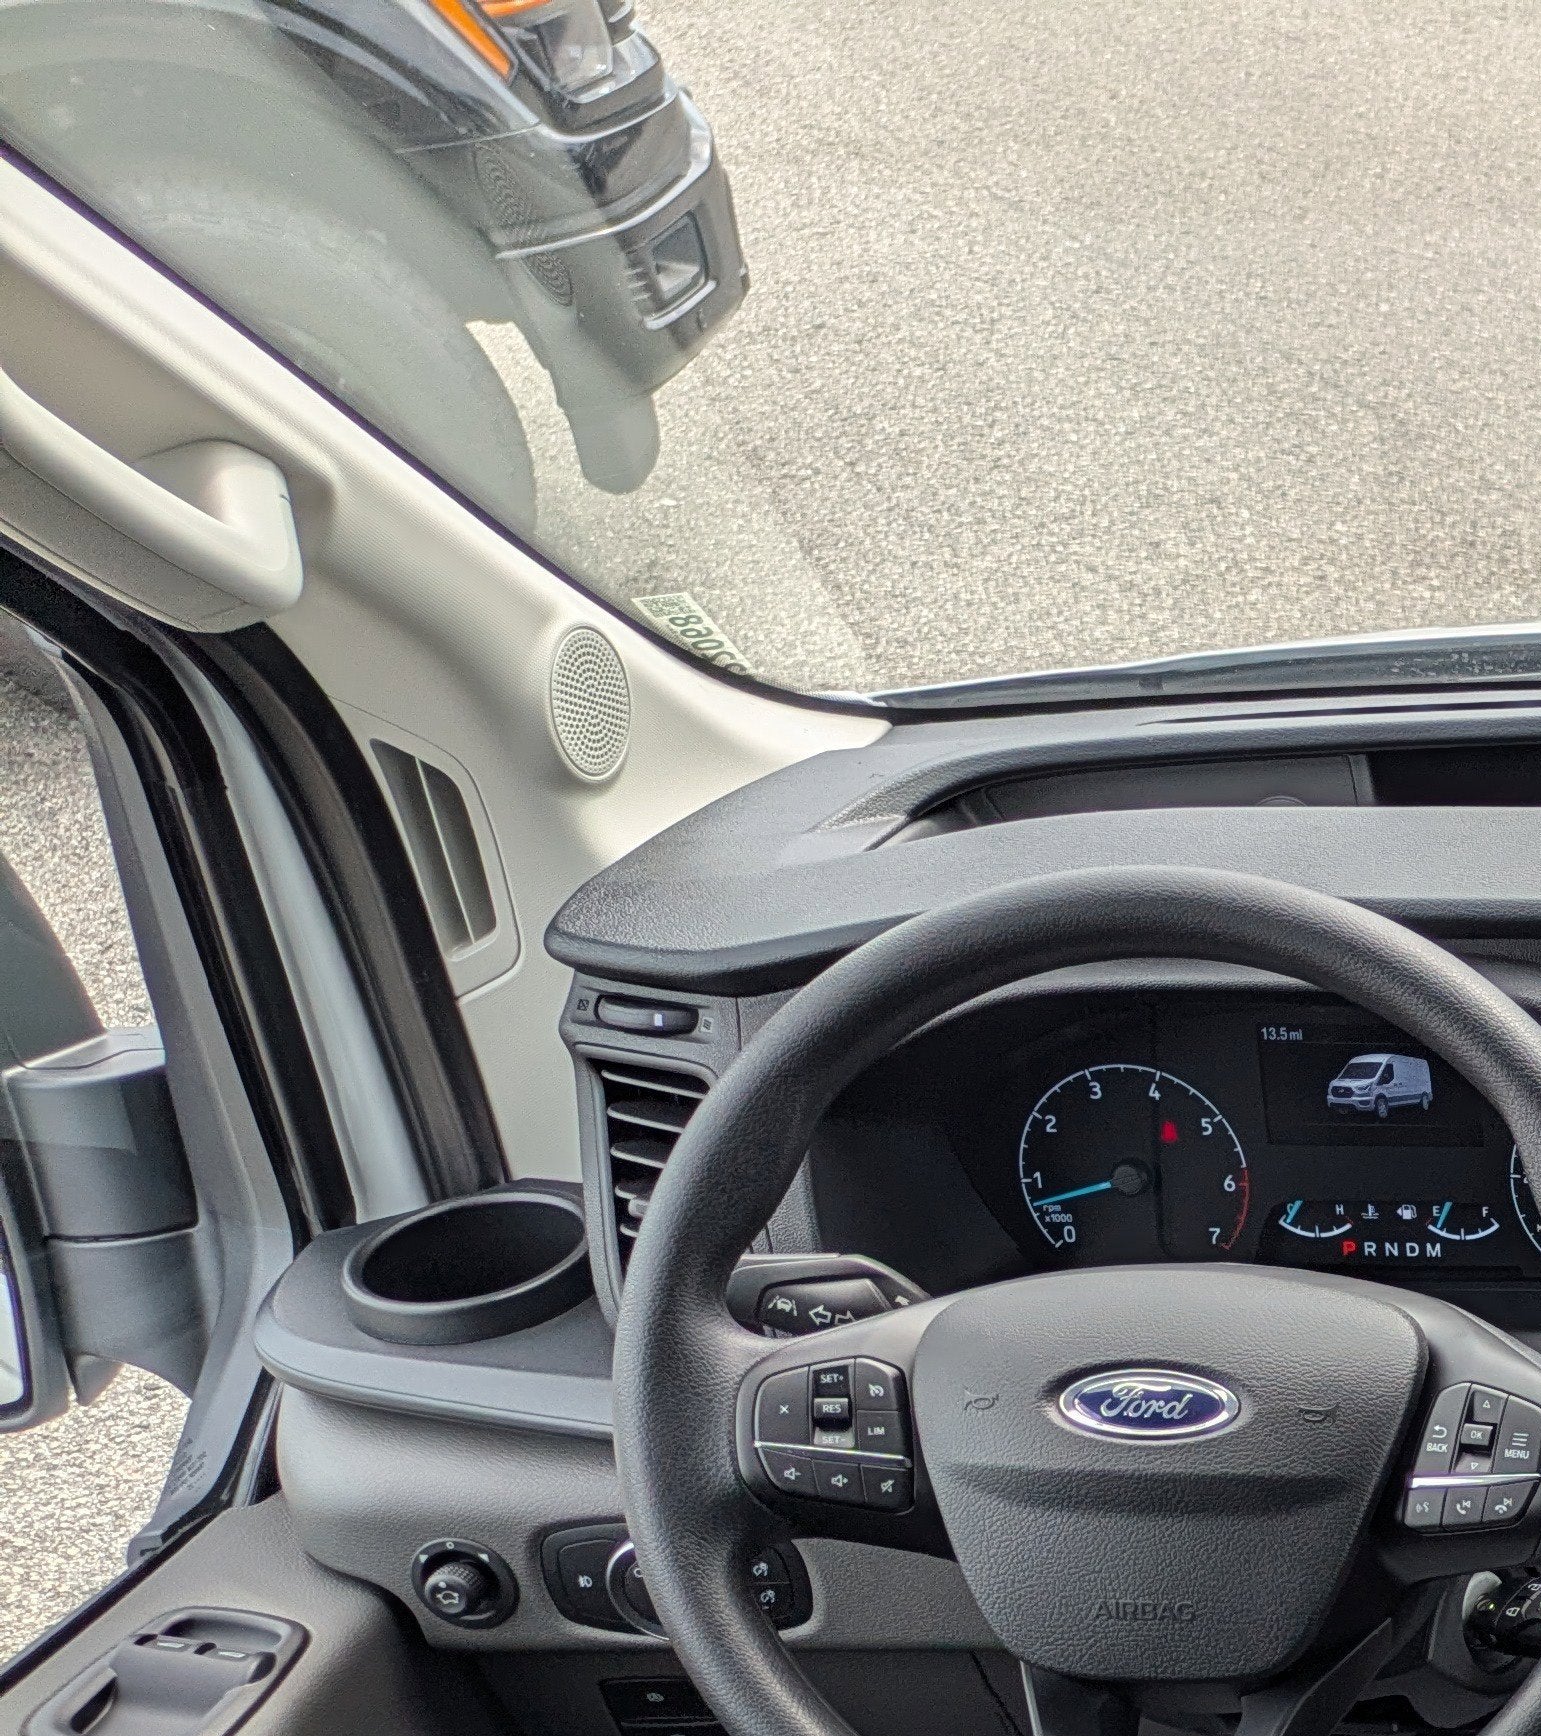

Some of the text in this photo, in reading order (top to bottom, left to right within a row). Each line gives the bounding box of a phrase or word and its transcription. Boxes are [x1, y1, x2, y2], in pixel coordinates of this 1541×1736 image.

[1089, 1081, 1102, 1100] 3
[1149, 1082, 1161, 1100] 4
[1045, 1115, 1057, 1133] 2
[1201, 1118, 1213, 1135] 5
[1033, 1171, 1043, 1189] 1
[1223, 1174, 1236, 1192] 6
[1042, 1204, 1062, 1213] rpm
[1335, 1204, 1344, 1215] H
[1432, 1205, 1441, 1217] E
[1482, 1206, 1489, 1217] F
[1063, 1225, 1076, 1243] 0
[1208, 1227, 1221, 1245] 7
[1342, 1240, 1442, 1258] P R N D M
[822, 1404, 842, 1413] RES
[1100, 1382, 1194, 1421] Ford
[867, 1426, 885, 1436] LIM
[1470, 1430, 1483, 1440] OK
[1426, 1442, 1448, 1453] BACK
[1504, 1449, 1530, 1460] MENU
[1095, 1601, 1197, 1622] AIRBAG
